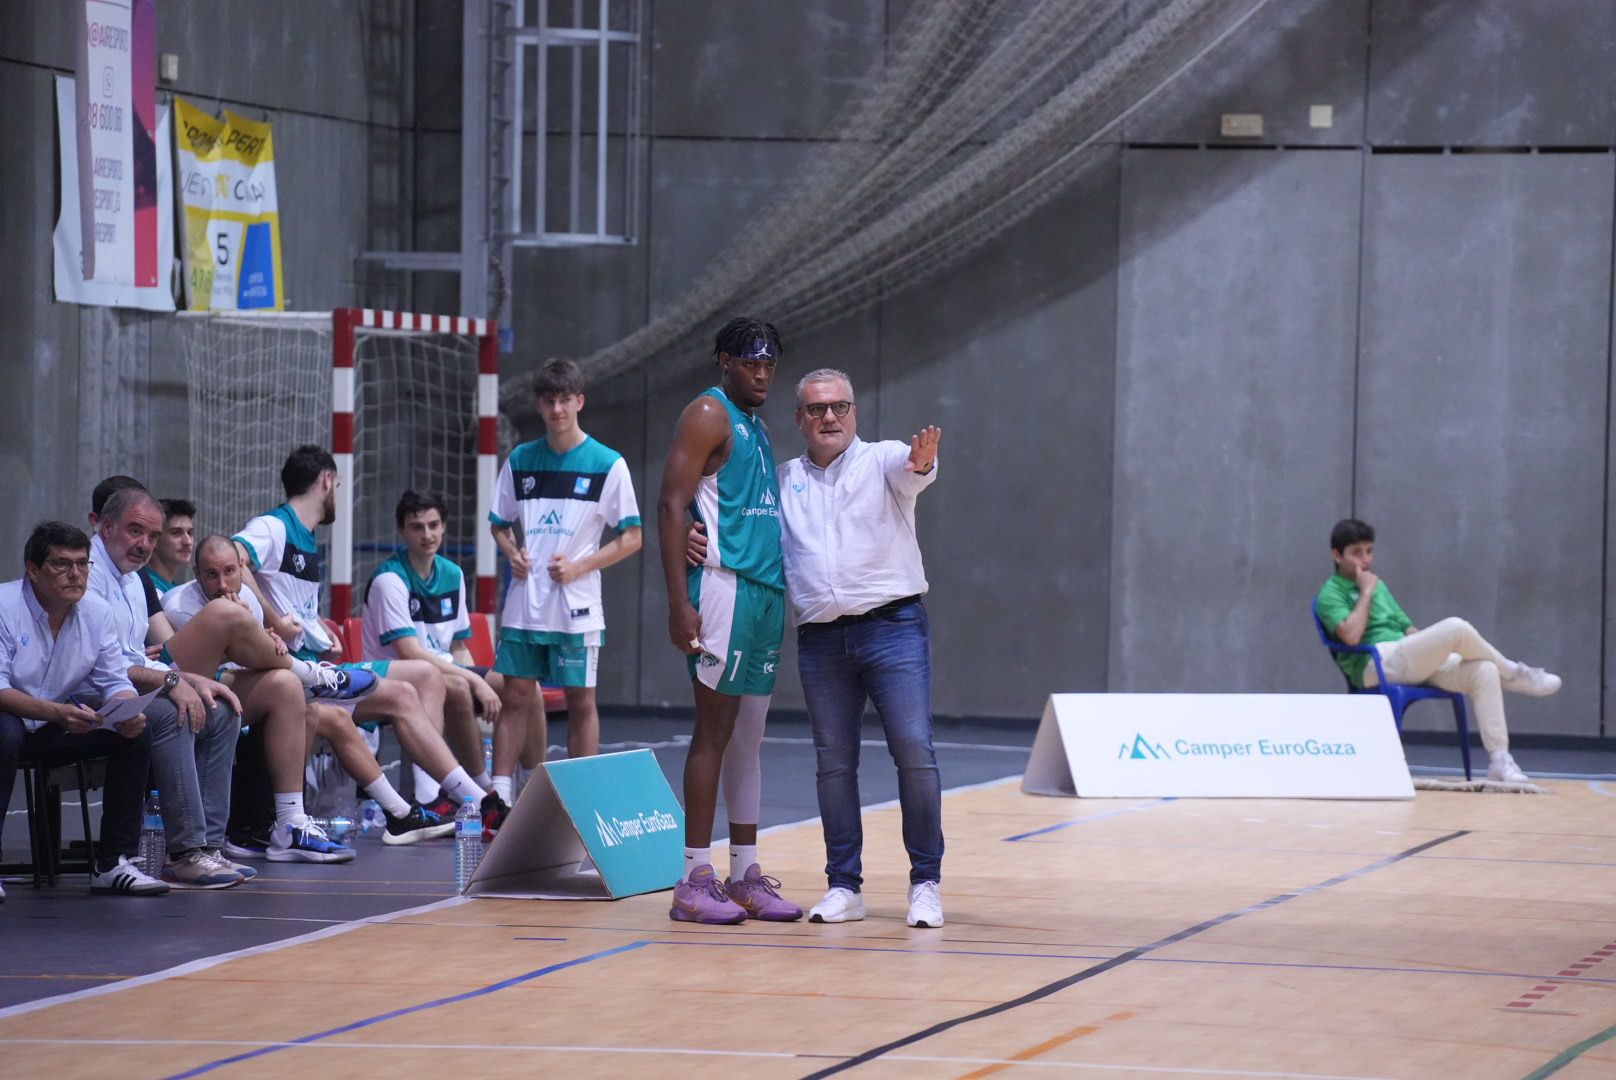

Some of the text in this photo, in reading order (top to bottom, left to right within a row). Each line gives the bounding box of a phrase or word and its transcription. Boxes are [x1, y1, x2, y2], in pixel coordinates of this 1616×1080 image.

[217, 232, 230, 266] 5
[741, 507, 768, 518] Camper
[729, 650, 743, 681] 7
[1174, 738, 1357, 759] Camper EuroGaza
[612, 809, 678, 841] Camper EuroGaza
